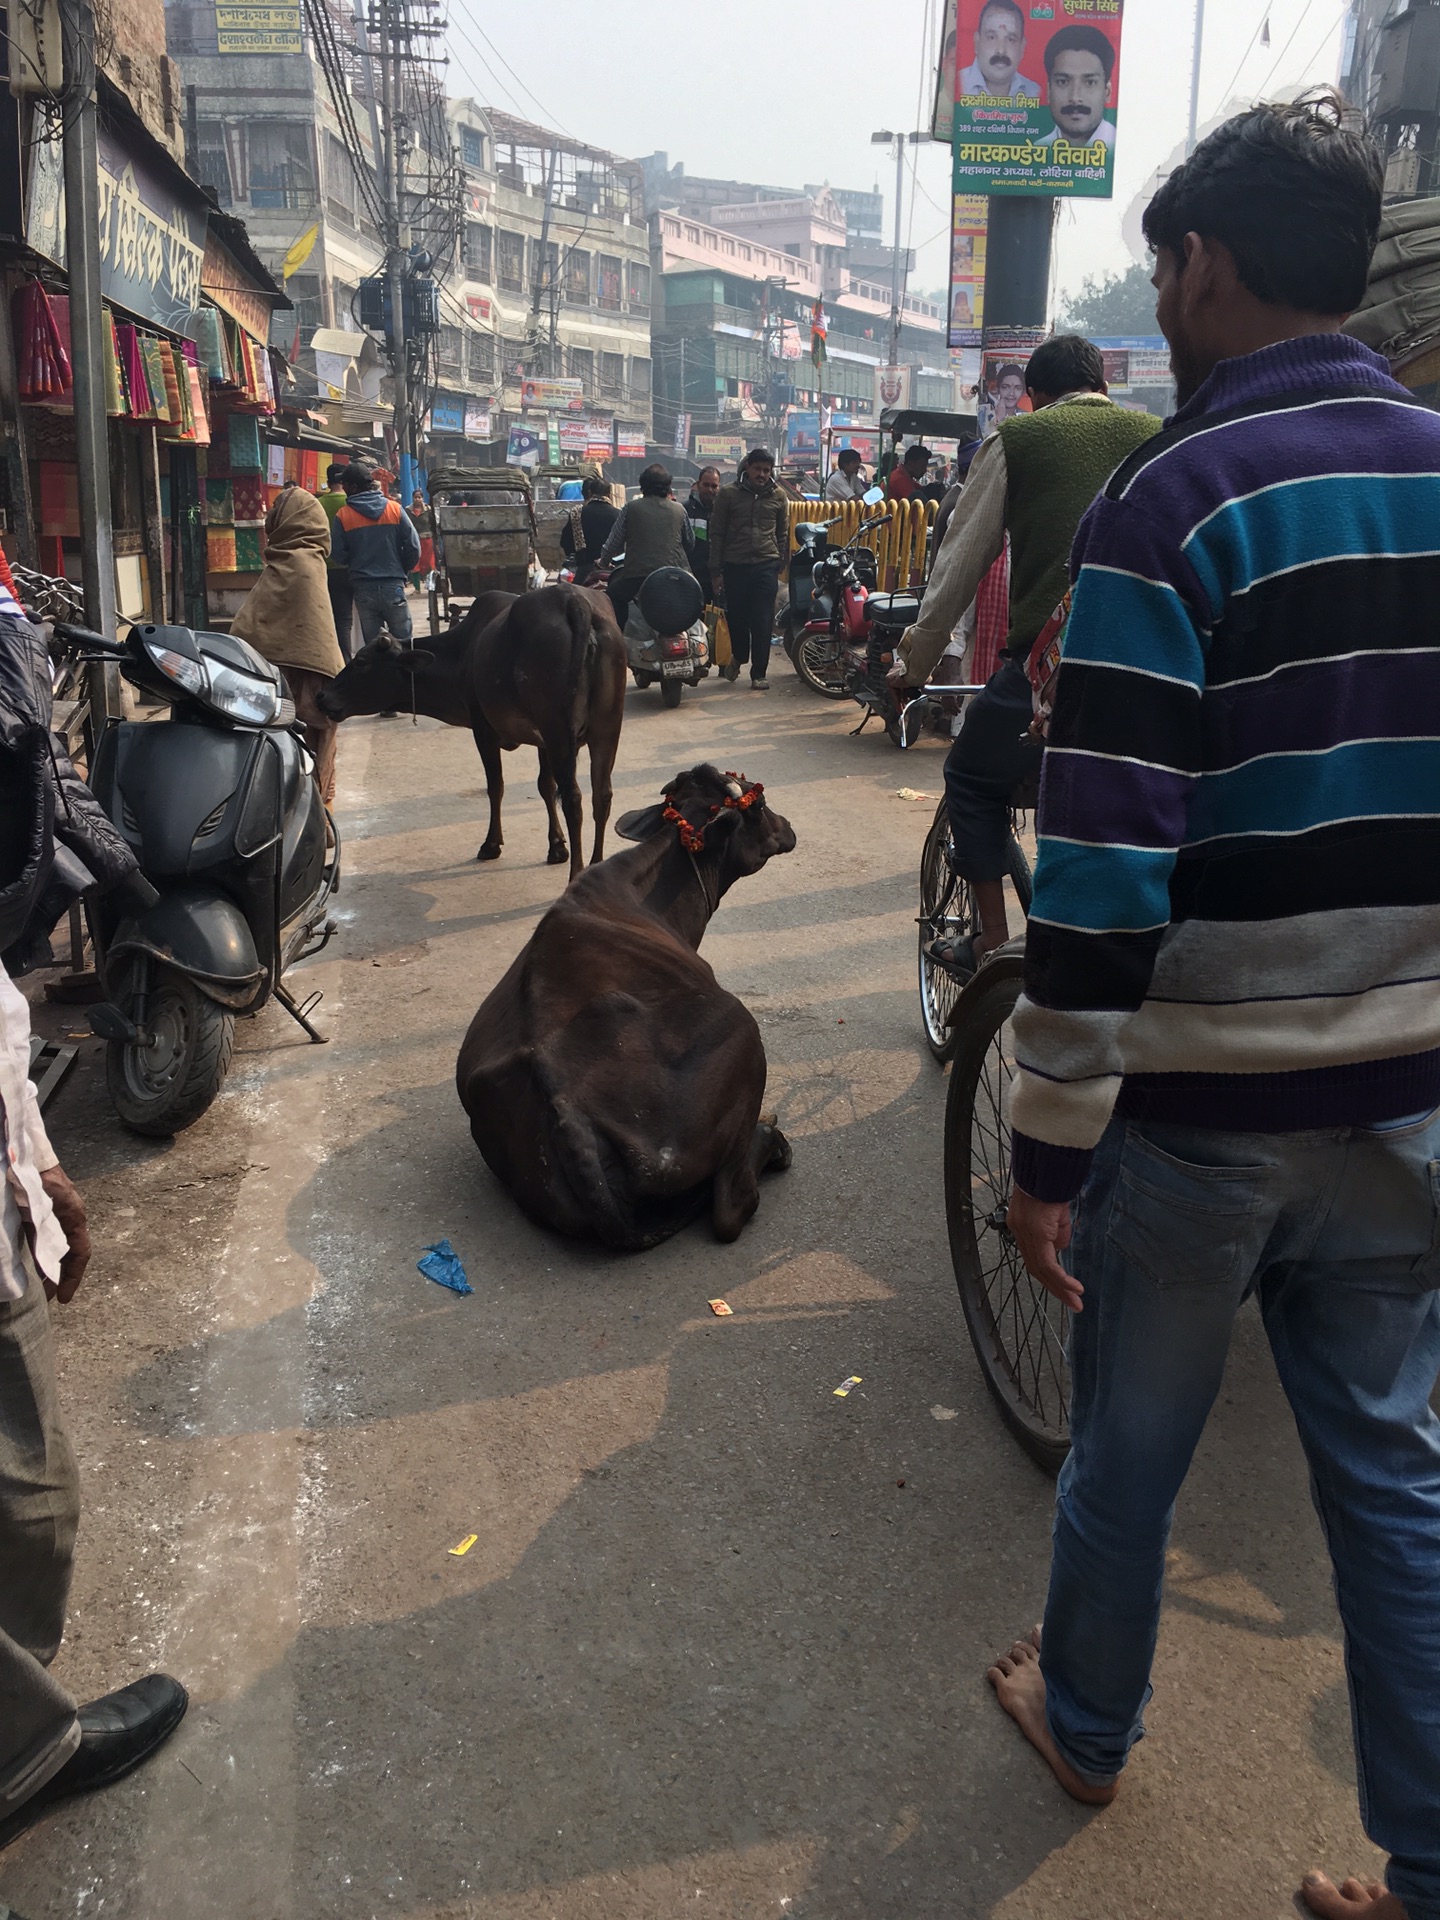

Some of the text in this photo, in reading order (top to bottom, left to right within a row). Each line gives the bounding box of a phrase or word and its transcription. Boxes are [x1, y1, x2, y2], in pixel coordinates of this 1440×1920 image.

[1016, 92, 1040, 109] मिश्रा
[959, 138, 1107, 167] मारकण्डेय तिवारी
[959, 166, 1001, 175] महानगर
[1039, 165, 1072, 178] लोहिया
[1075, 167, 1106, 180] वाहिनी
[991, 178, 1027, 187] समाजवादी
